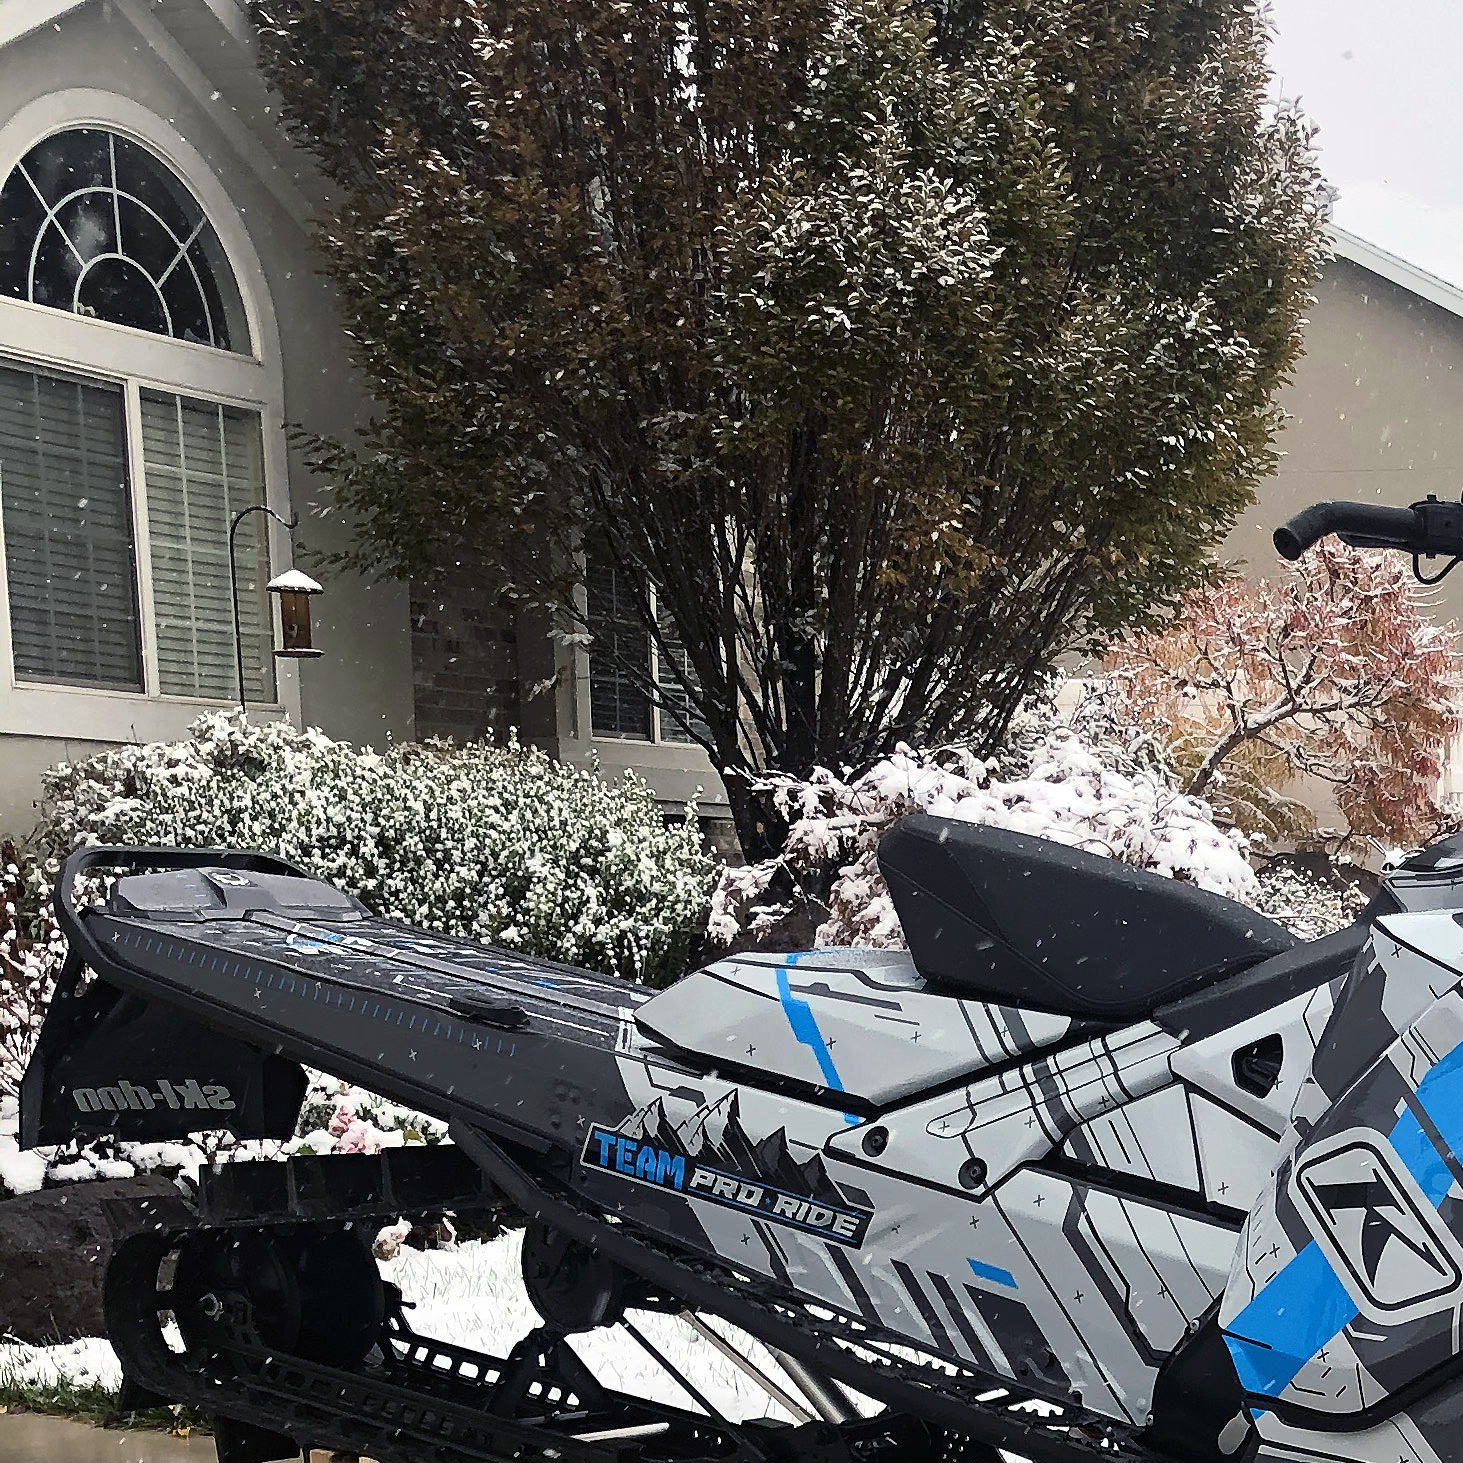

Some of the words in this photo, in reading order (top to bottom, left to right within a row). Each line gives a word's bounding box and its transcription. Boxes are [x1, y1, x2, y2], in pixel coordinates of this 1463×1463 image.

[594, 1130, 686, 1191] TEAM
[689, 1167, 763, 1207] PRO
[772, 1194, 860, 1236] RIDE
